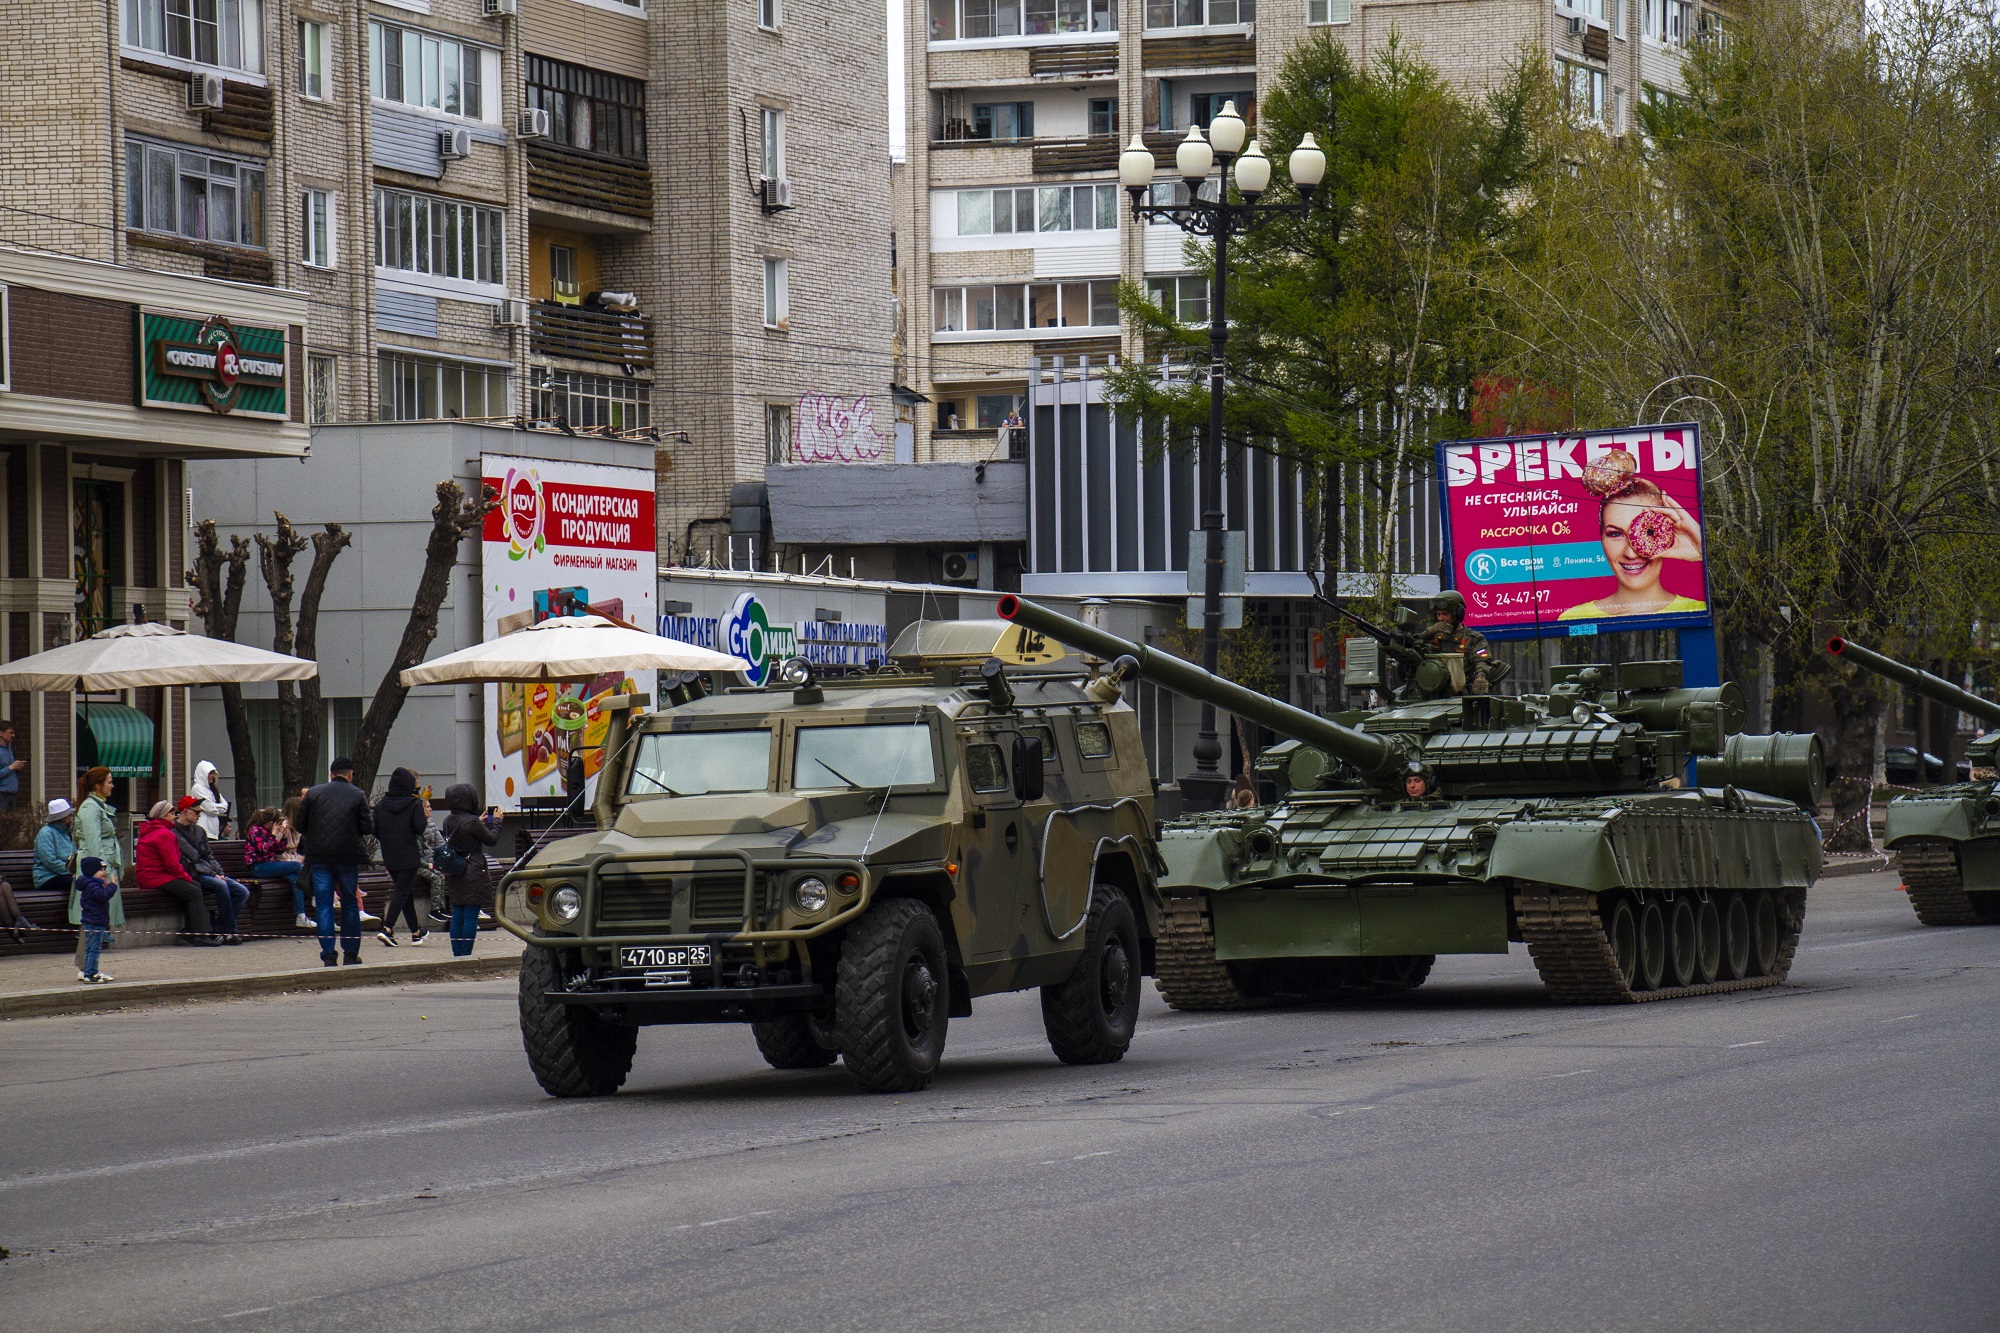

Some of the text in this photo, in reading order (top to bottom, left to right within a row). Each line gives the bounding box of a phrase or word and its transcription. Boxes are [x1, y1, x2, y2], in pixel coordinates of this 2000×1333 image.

[207, 329, 231, 345] РЕСТОРА
[166, 350, 217, 369] GUSTAV
[239, 358, 284, 377] GUSTAV
[513, 493, 535, 511] KDV
[552, 492, 639, 519] КОНДИТЕРСКАЯ
[1465, 489, 1562, 506] НЕ СТЕСНЯЙСЯ,
[1503, 502, 1578, 518] УЛЫБАЙСЯ!
[561, 518, 631, 546] ПРОДУКЦИЯ
[1480, 524, 1548, 538] РАССРОЧКА
[553, 553, 638, 571] ФИРМЕННЫЙ МАГАЗИН
[1500, 557, 1544, 567] Все свои
[1596, 555, 1606, 563] 56
[1495, 589, 1551, 606] 24-47-97
[804, 620, 887, 643] МЫ КОНТРОЛИРУЕМ
[804, 645, 847, 664] КАЧЕСТВО
[853, 646, 859, 664] И
[627, 949, 665, 966] 4710
[690, 947, 706, 960] 25
